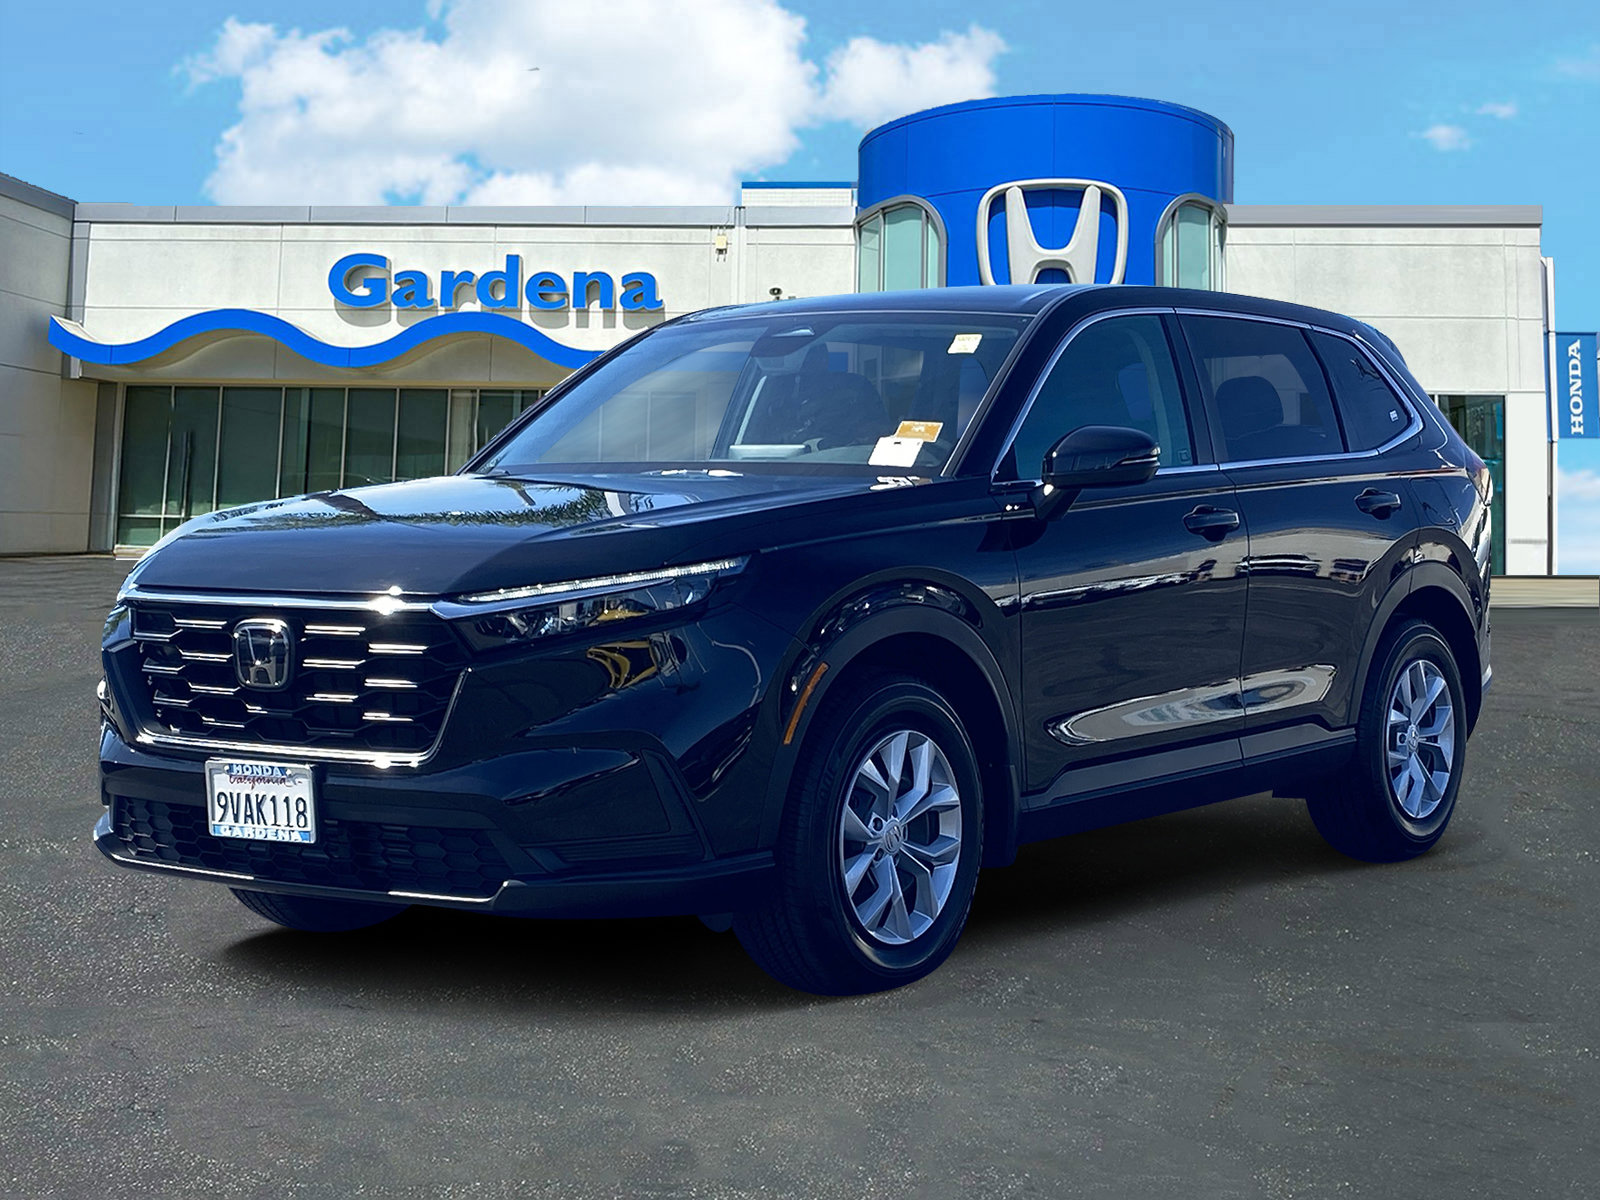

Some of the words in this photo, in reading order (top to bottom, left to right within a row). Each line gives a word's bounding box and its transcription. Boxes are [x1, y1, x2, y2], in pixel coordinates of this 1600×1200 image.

[328, 252, 665, 311] Gardena
[1567, 338, 1584, 436] HONDA
[231, 763, 283, 777] HONDA
[216, 791, 308, 829] 9VAK118
[219, 825, 304, 842] GARDENA
